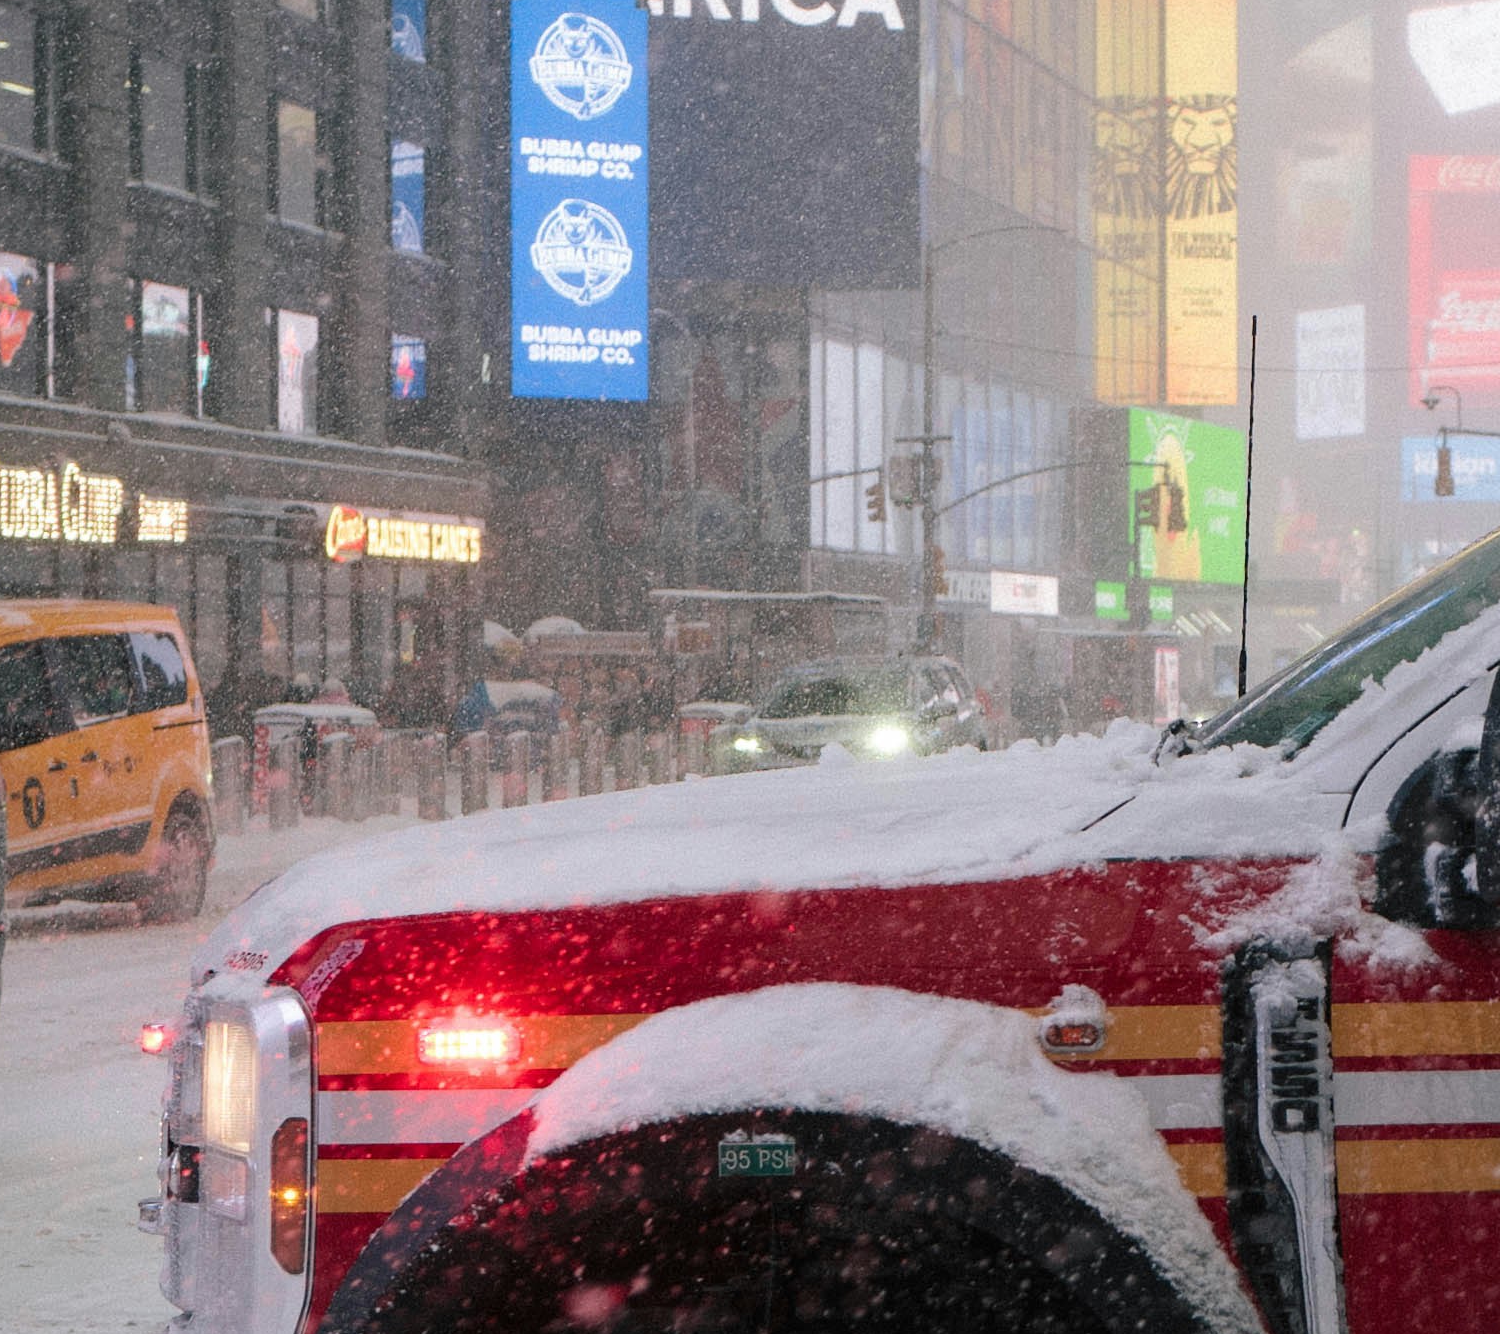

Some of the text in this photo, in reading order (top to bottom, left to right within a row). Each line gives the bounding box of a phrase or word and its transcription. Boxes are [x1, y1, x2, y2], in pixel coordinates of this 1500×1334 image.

[520, 137, 643, 162] BUBBA GUMP
[527, 155, 635, 180] SHRIMP CO.
[520, 324, 643, 347] BUBBA GUMP
[527, 344, 635, 366] SHRIMP CO.
[61, 462, 124, 544] GUMP
[367, 517, 481, 563] RAISING CANE'S
[726, 1149, 789, 1170] 95 PSI
